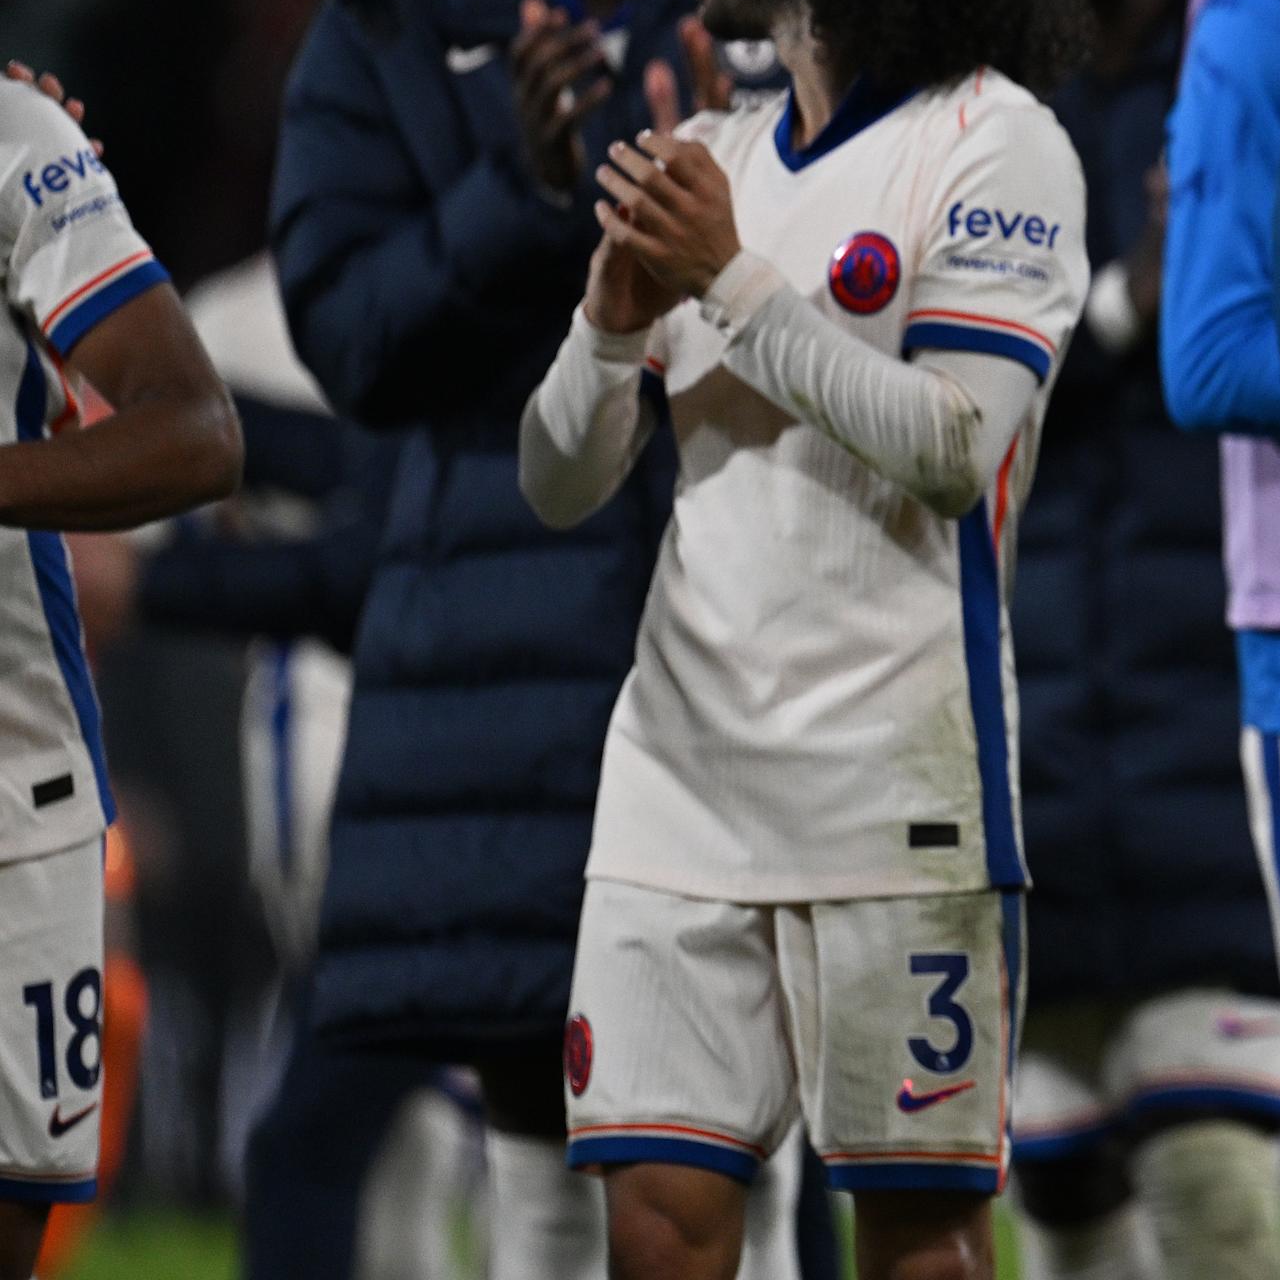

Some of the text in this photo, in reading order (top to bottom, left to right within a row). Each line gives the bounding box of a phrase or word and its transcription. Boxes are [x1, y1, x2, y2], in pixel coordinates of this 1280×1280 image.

[947, 201, 1061, 251] fever
[23, 966, 102, 1100] 18
[907, 953, 974, 1075] 3
